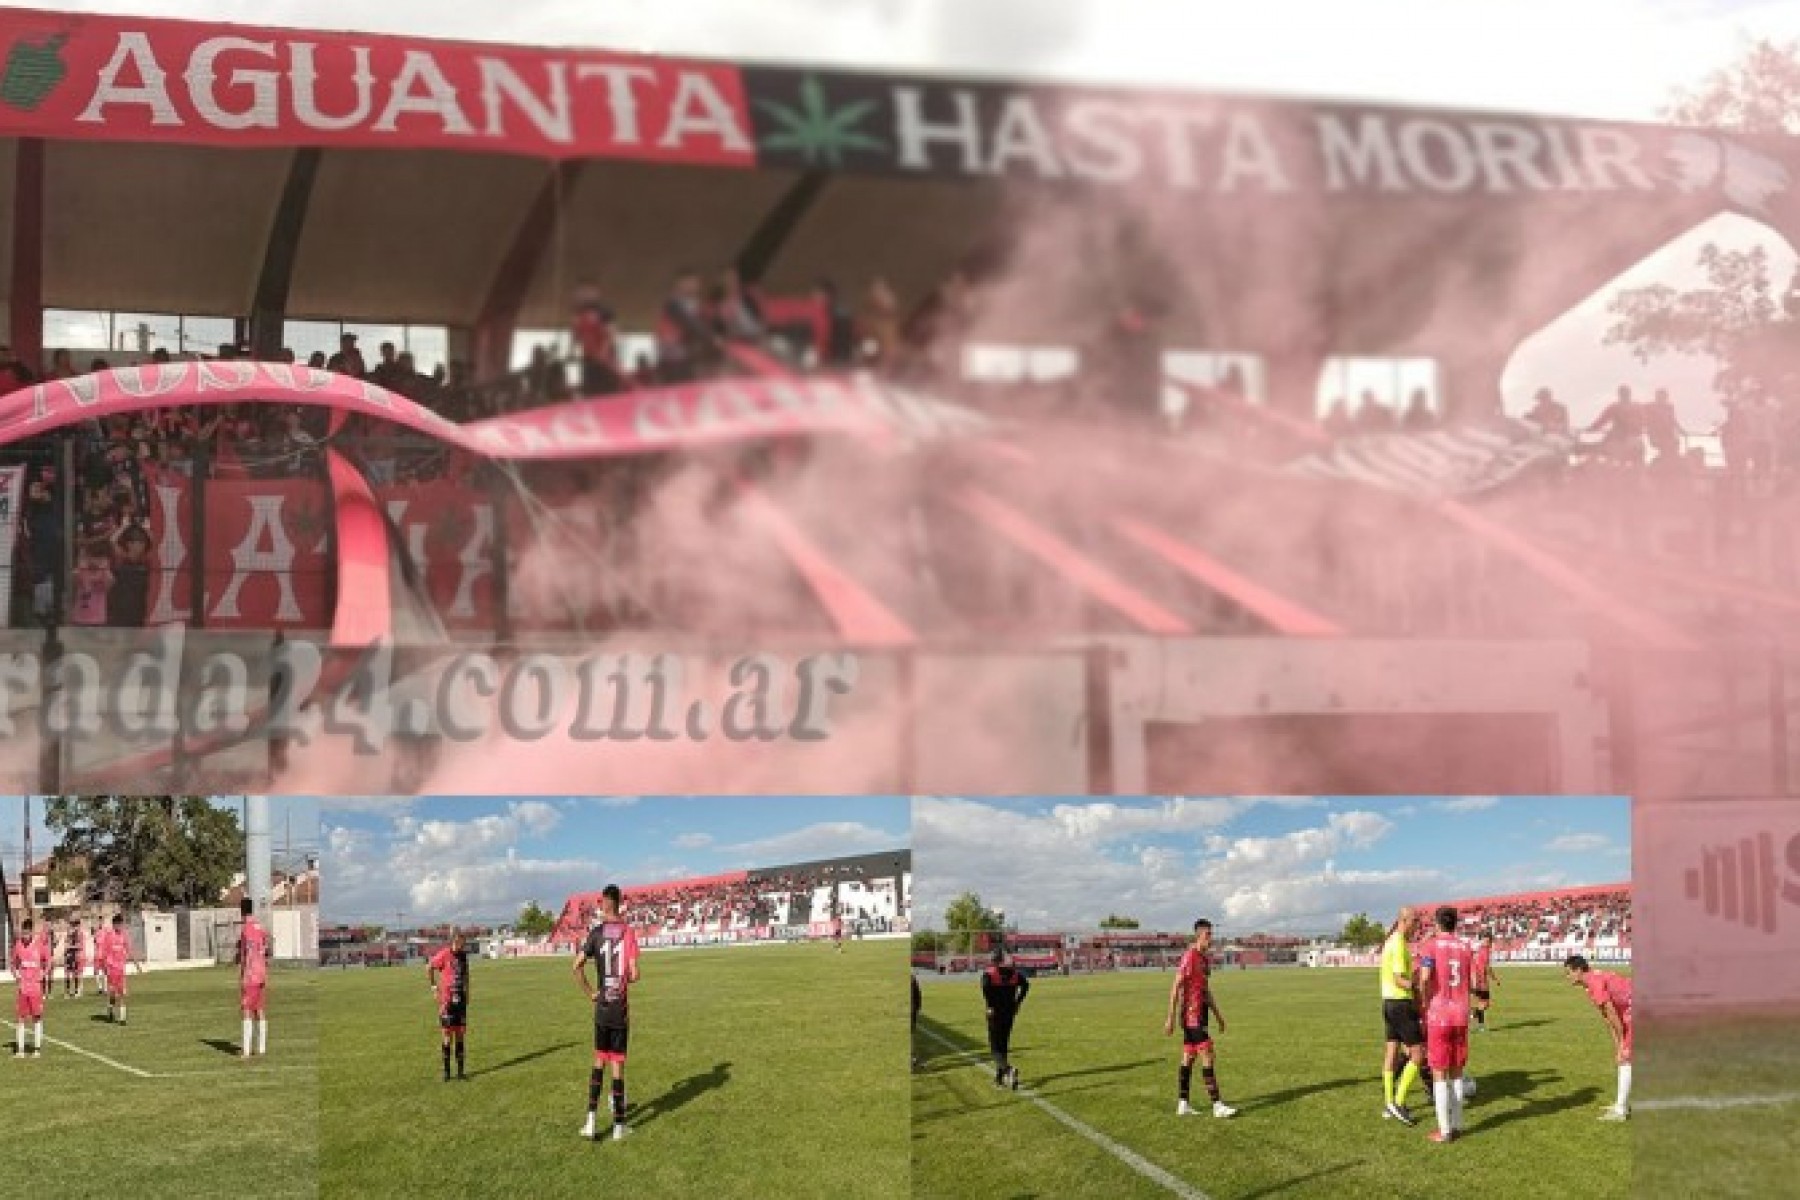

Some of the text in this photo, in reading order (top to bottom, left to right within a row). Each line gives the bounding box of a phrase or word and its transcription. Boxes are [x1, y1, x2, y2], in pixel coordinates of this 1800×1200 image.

[76, 30, 1664, 193] AGUANTA HASTA MORIR
[600, 939, 625, 976] 11
[1449, 960, 1462, 987] 3
